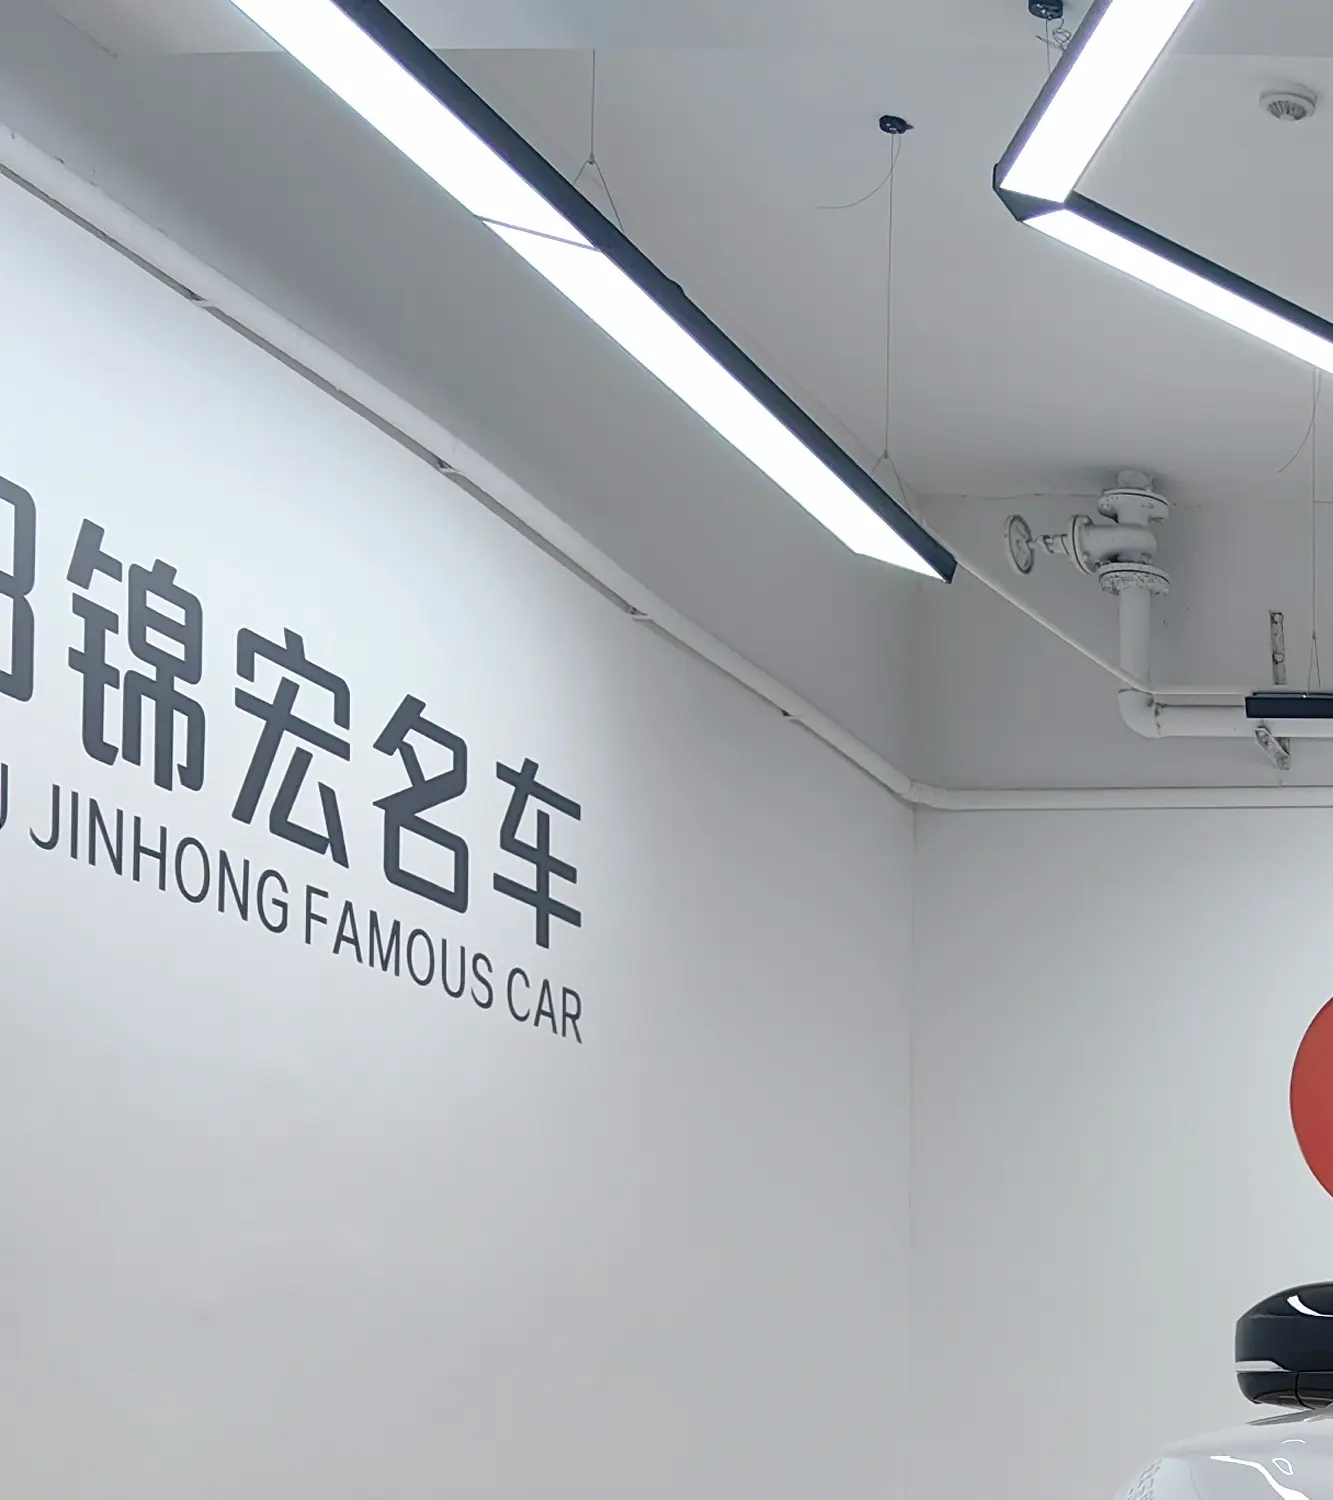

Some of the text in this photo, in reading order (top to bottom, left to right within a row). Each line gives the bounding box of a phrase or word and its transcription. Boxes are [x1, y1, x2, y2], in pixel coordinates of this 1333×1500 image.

[29, 783, 289, 934] JINHONG
[305, 884, 494, 1010] FAMOUS
[507, 967, 583, 1044] CAR
